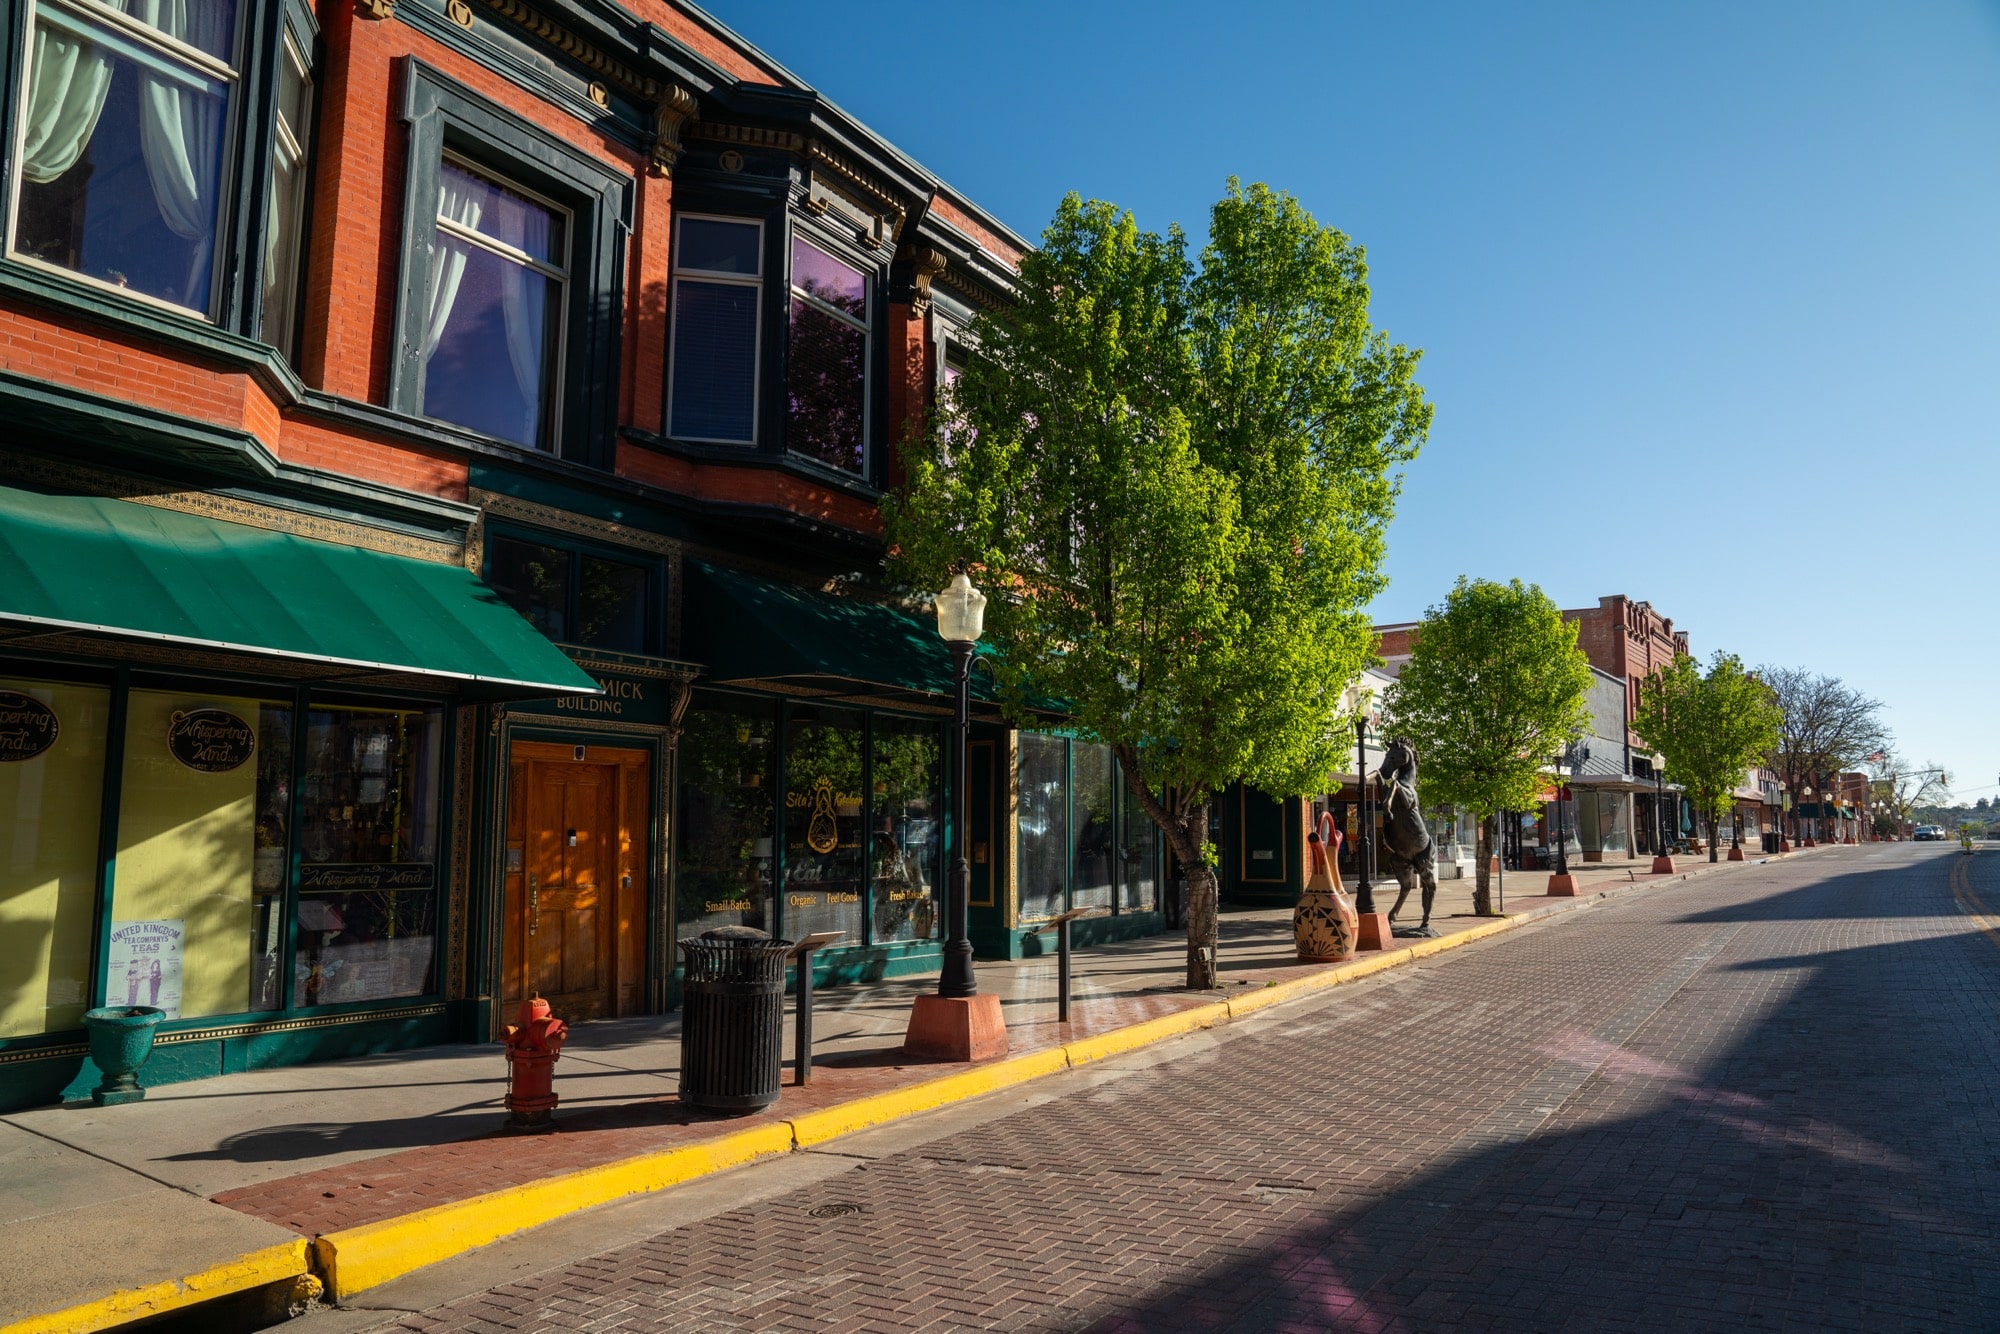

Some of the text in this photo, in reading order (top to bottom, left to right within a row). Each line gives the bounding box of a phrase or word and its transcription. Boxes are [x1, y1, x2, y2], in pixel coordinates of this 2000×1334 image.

[557, 696, 622, 714] BUILDING
[176, 717, 249, 746] Whispering
[191, 741, 232, 761] Wind
[785, 790, 814, 808] Sita's
[302, 866, 381, 888] Whispering
[386, 868, 425, 884] Wind
[790, 894, 817, 908] Organic
[827, 891, 858, 904] Feel Good
[890, 890, 906, 901] Fresh
[704, 898, 751, 913] Small Batch
[111, 923, 181, 943] UNITED KINGDOM
[124, 937, 137, 945] TEA
[131, 943, 160, 952] TEAS
